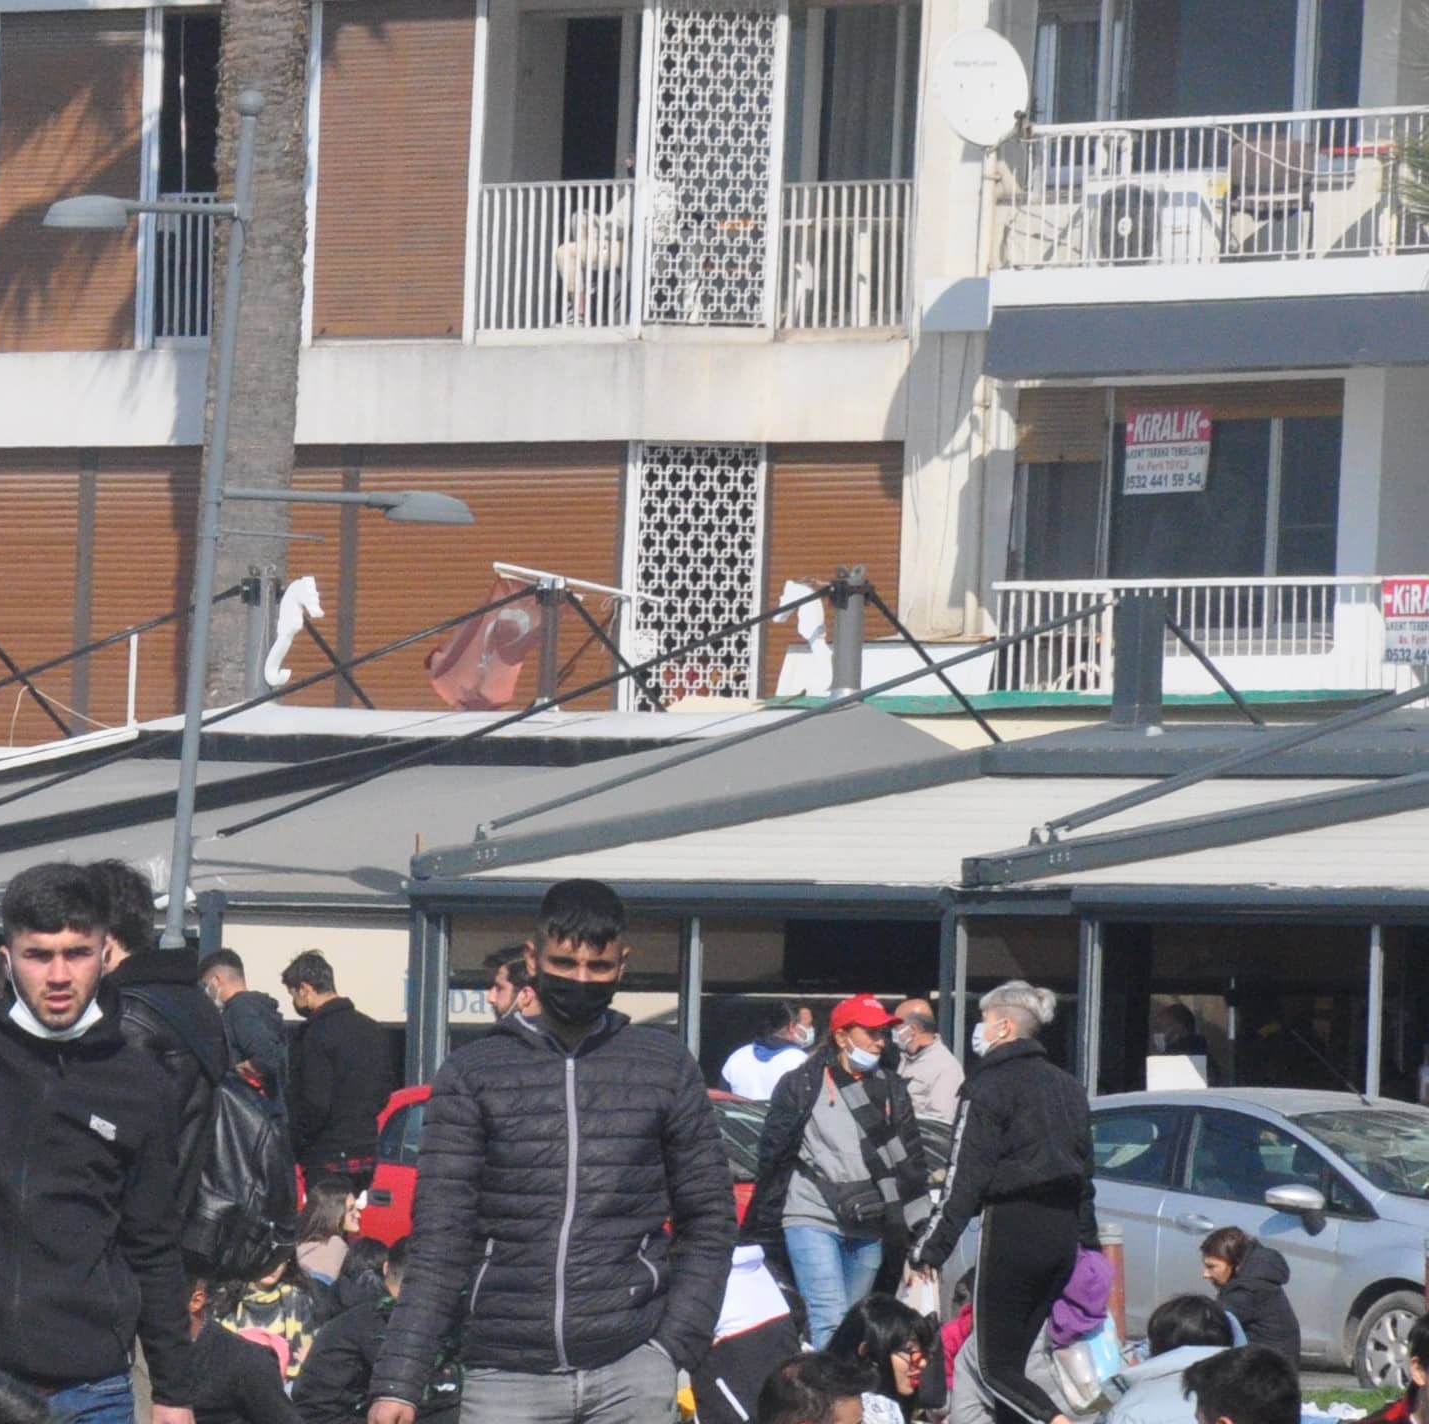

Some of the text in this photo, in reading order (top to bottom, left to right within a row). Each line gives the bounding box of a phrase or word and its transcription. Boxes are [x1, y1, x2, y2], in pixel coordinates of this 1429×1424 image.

[1150, 474, 1168, 488] 441
[1187, 472, 1201, 486] 54
[1386, 648, 1429, 662] 0532 44
